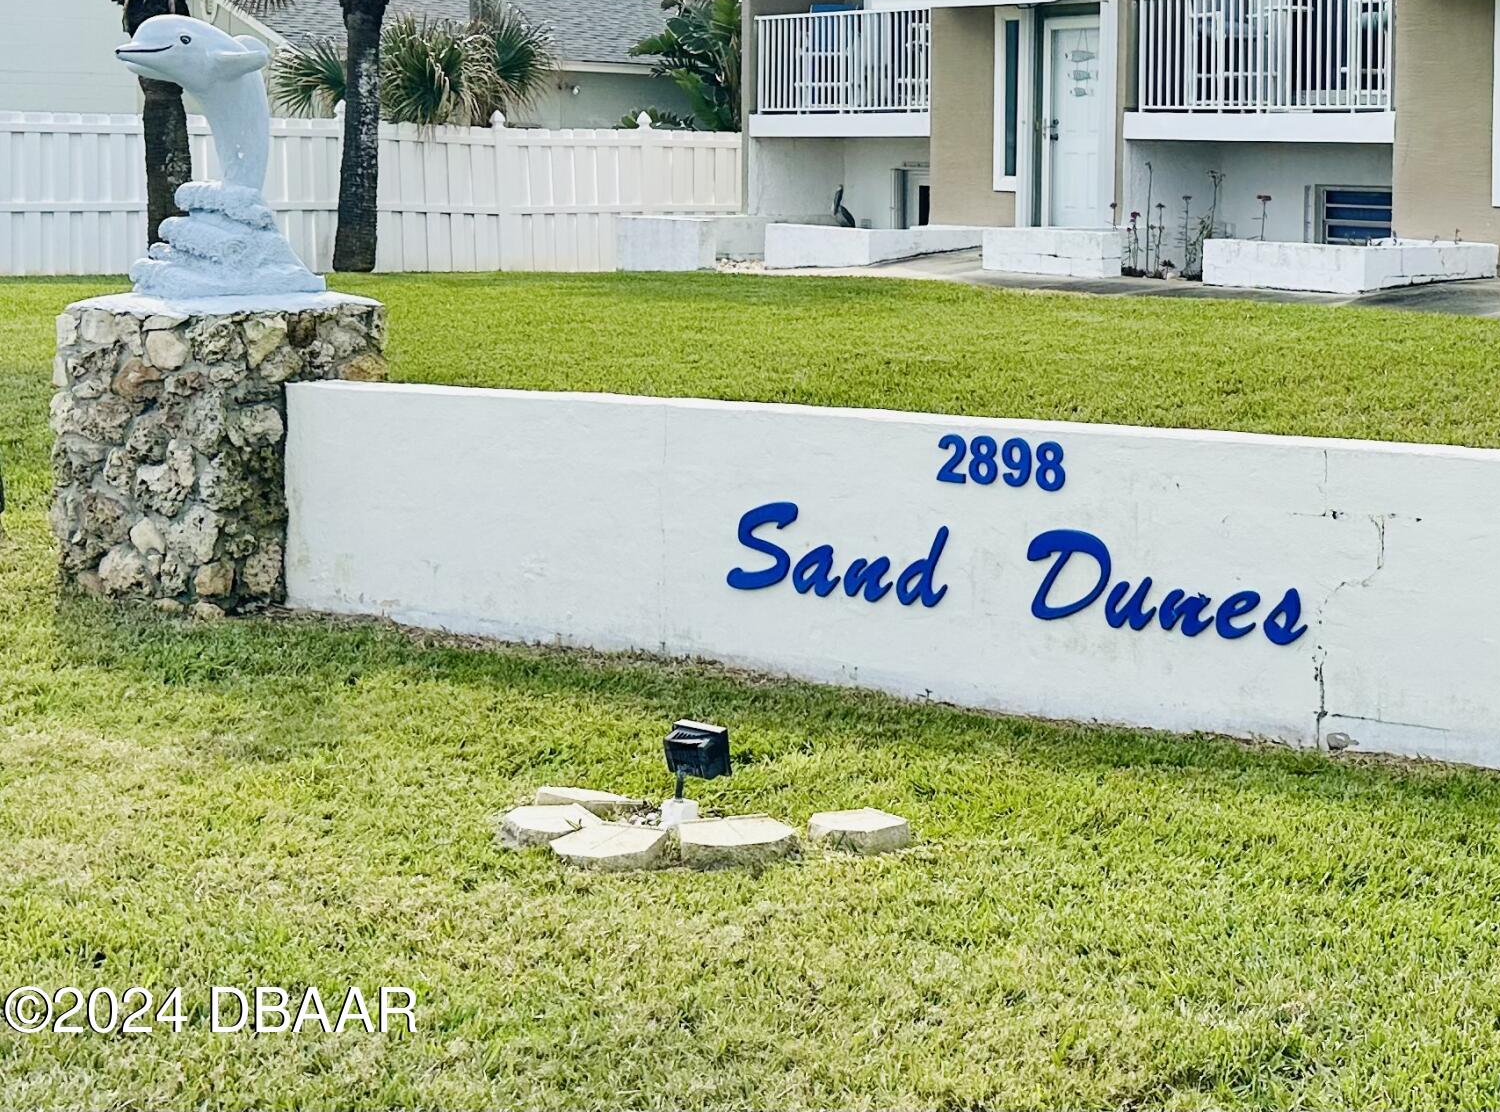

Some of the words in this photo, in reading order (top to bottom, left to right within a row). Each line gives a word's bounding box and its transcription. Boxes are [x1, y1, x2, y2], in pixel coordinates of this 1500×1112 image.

[937, 434, 1066, 492] 2898
[727, 501, 949, 607] Sand
[1026, 528, 1308, 645] Dunes
